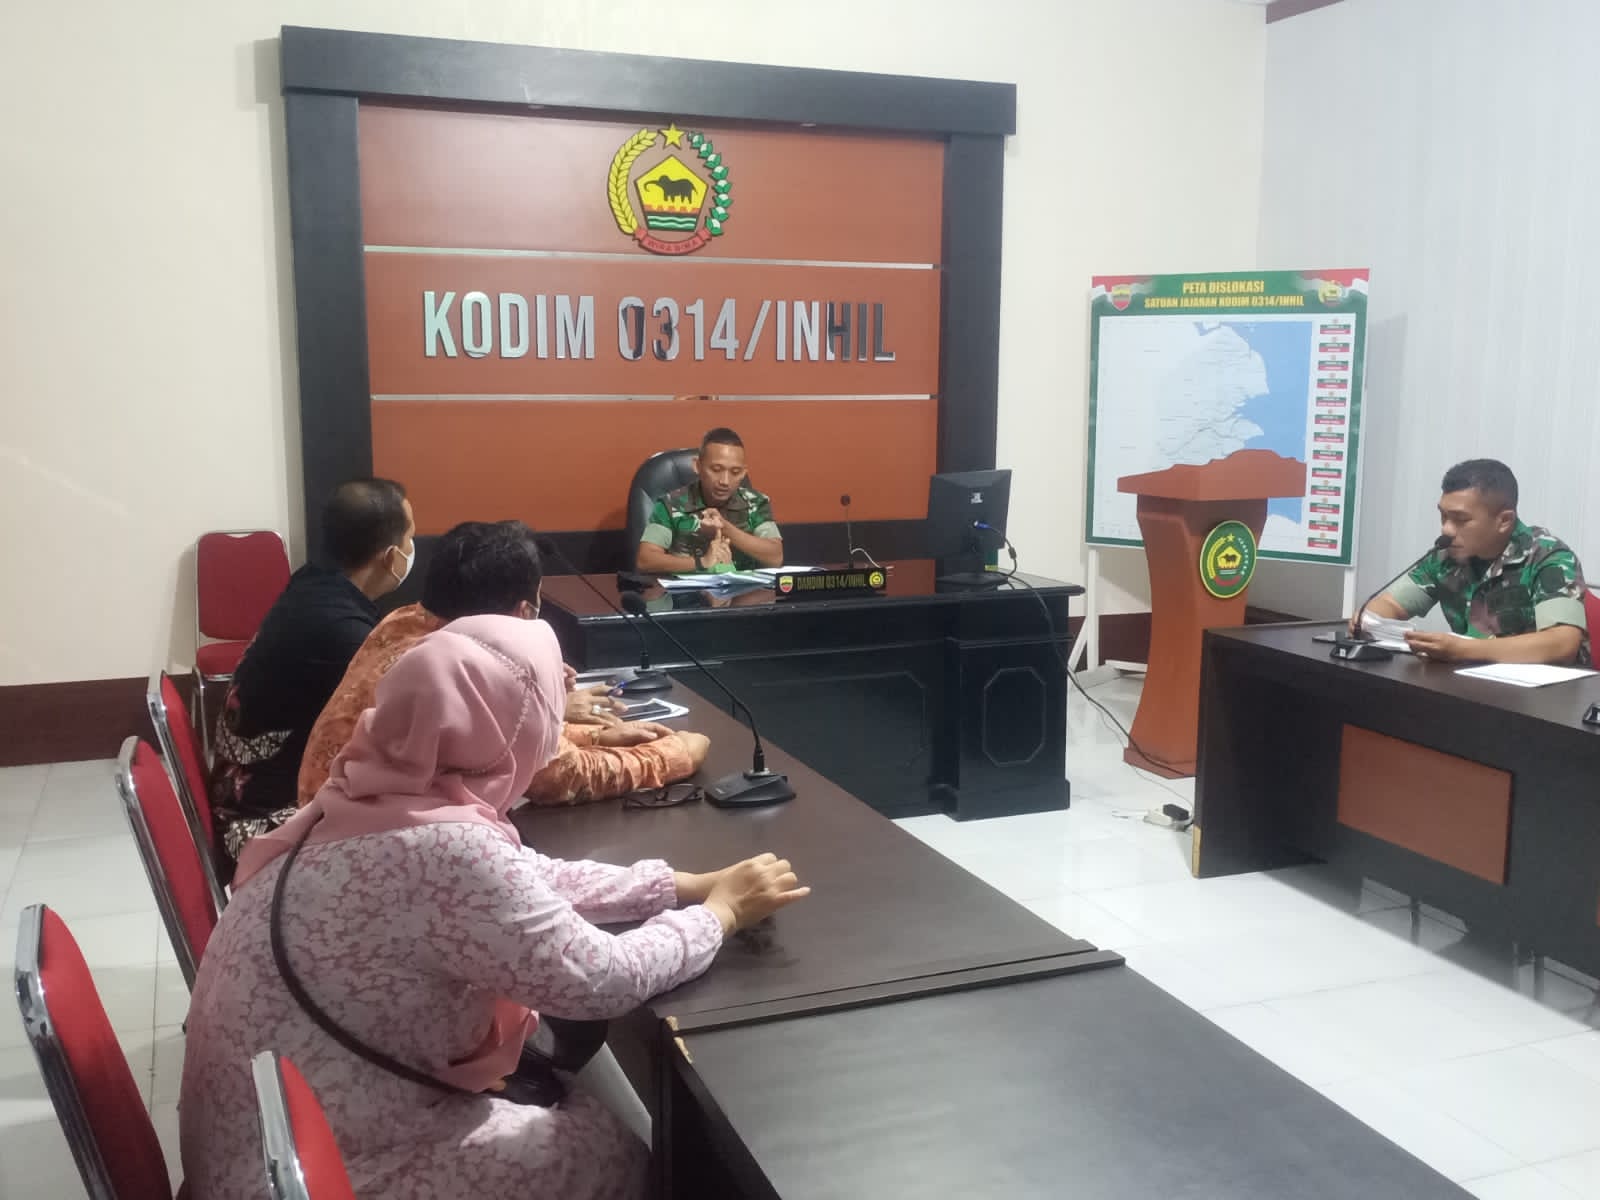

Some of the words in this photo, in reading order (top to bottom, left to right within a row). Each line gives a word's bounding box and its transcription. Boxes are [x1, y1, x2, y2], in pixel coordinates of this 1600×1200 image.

[1182, 281, 1207, 294] PETA
[1208, 280, 1265, 294] DISLOKASI
[1144, 297, 1178, 309] SATUAN
[1180, 297, 1217, 308] JAJARAN
[1219, 296, 1250, 308] KODIM
[1252, 295, 1305, 308] 0314/INHIL
[424, 290, 595, 359] KODIM
[617, 296, 897, 362] 0314/INHIL
[797, 575, 825, 592] DANDIM
[826, 573, 865, 590] 0314/INHIL
